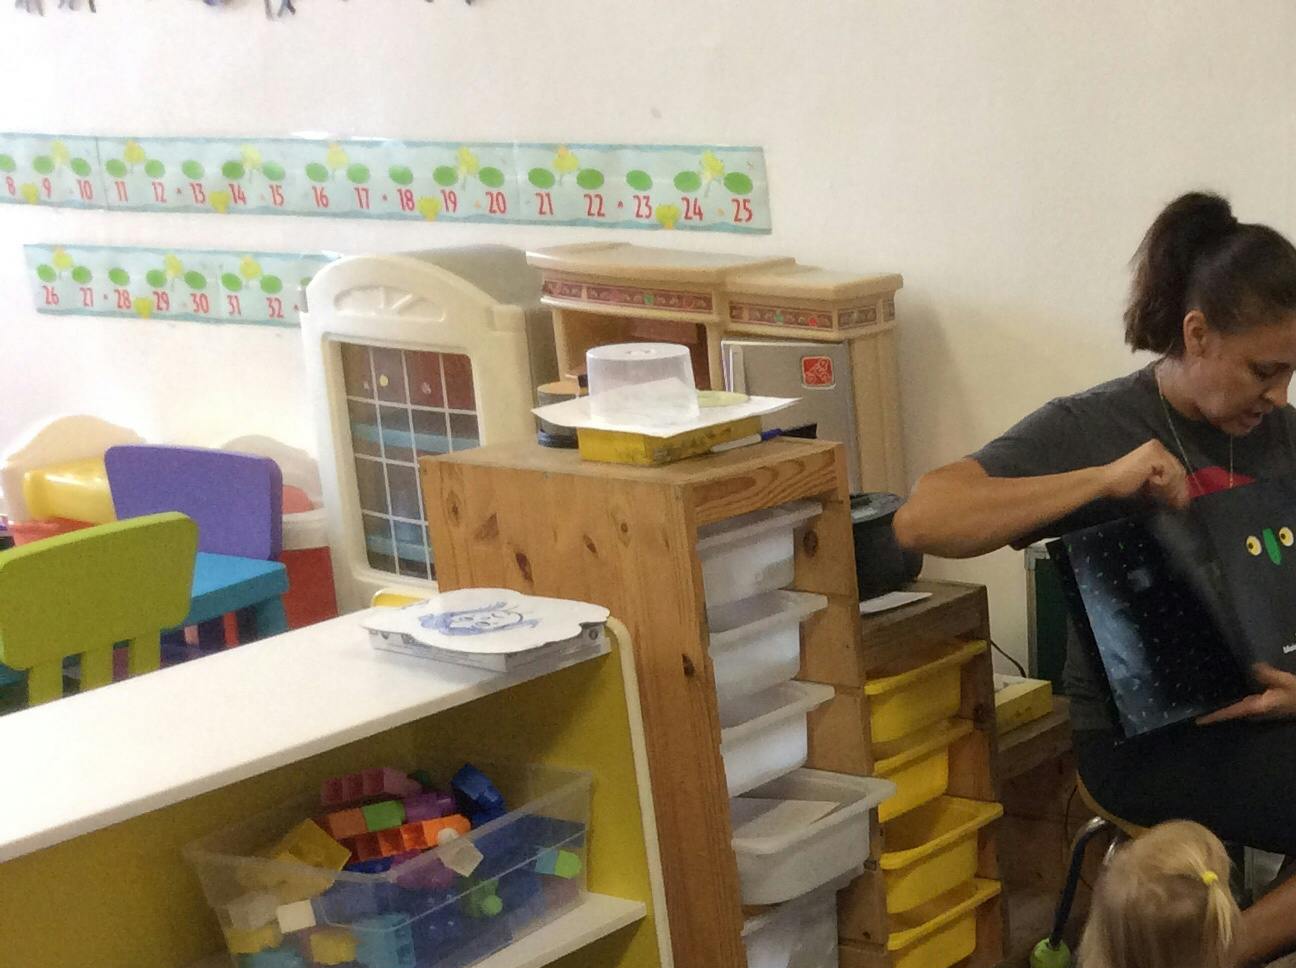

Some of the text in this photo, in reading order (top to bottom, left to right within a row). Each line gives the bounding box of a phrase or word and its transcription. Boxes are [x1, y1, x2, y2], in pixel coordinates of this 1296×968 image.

[6, 176, 752, 222] 8 9 10 11 12 13 14 15 16 17 18 19 20 21 22 23 24 25
[42, 286, 284, 319] 26 27 28 29 30 31 32
